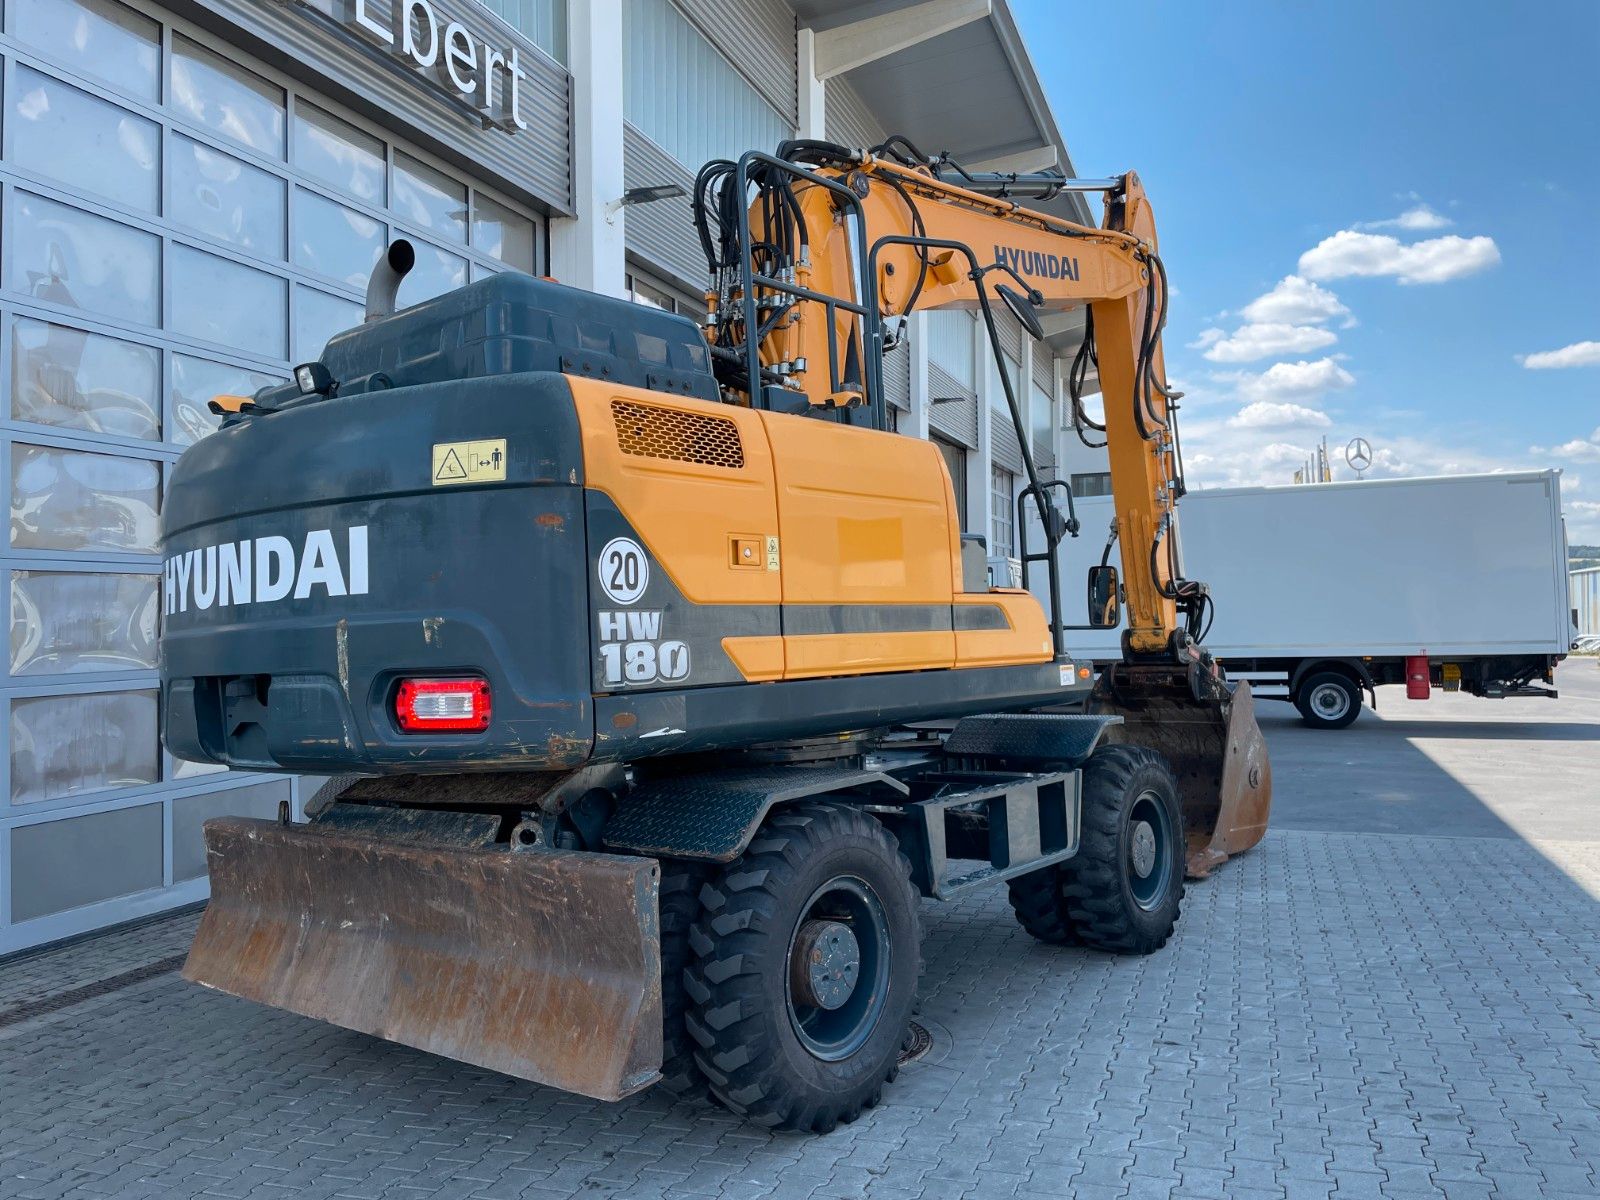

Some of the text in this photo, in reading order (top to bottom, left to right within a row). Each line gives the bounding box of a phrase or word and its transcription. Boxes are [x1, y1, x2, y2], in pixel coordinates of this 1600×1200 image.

[994, 245, 1079, 281] HYUNDAI
[165, 525, 369, 616] HYUNDAI
[609, 550, 639, 591] 20
[599, 611, 662, 641] HW
[600, 641, 690, 684] 180
